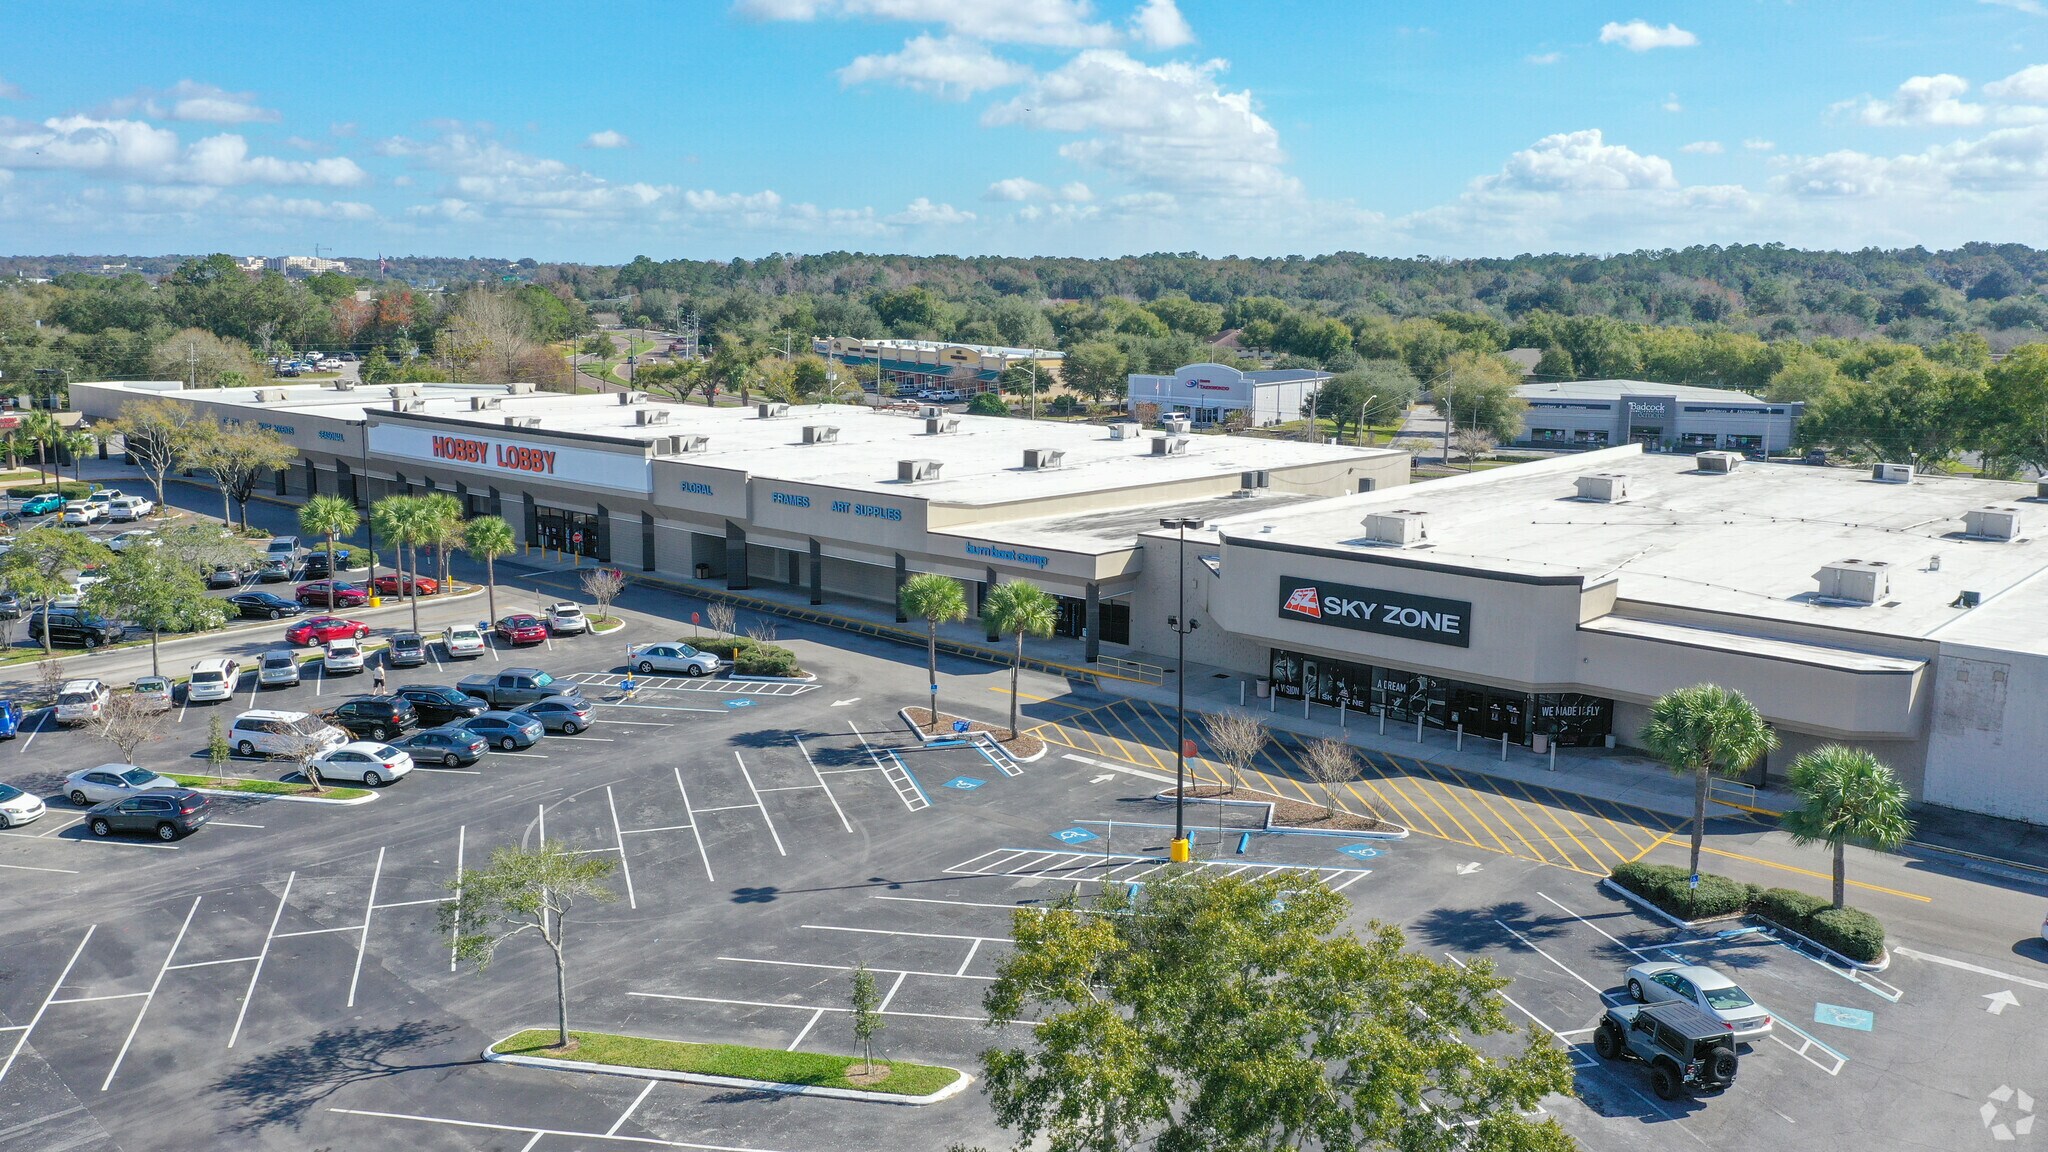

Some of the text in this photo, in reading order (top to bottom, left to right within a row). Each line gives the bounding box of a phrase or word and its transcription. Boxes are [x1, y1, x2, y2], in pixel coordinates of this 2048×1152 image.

[1630, 402, 1665, 411] Badcock
[318, 430, 345, 442] SEASONAL
[432, 436, 556, 474] HOBBY LOBBY
[680, 481, 713, 496] FLORAL
[772, 491, 810, 508] FRAMES
[831, 501, 902, 522] ART SUPPLIES
[1323, 596, 1461, 634] SKY ZONE
[1542, 706, 1554, 717] WE
[1586, 706, 1600, 716] FLY
